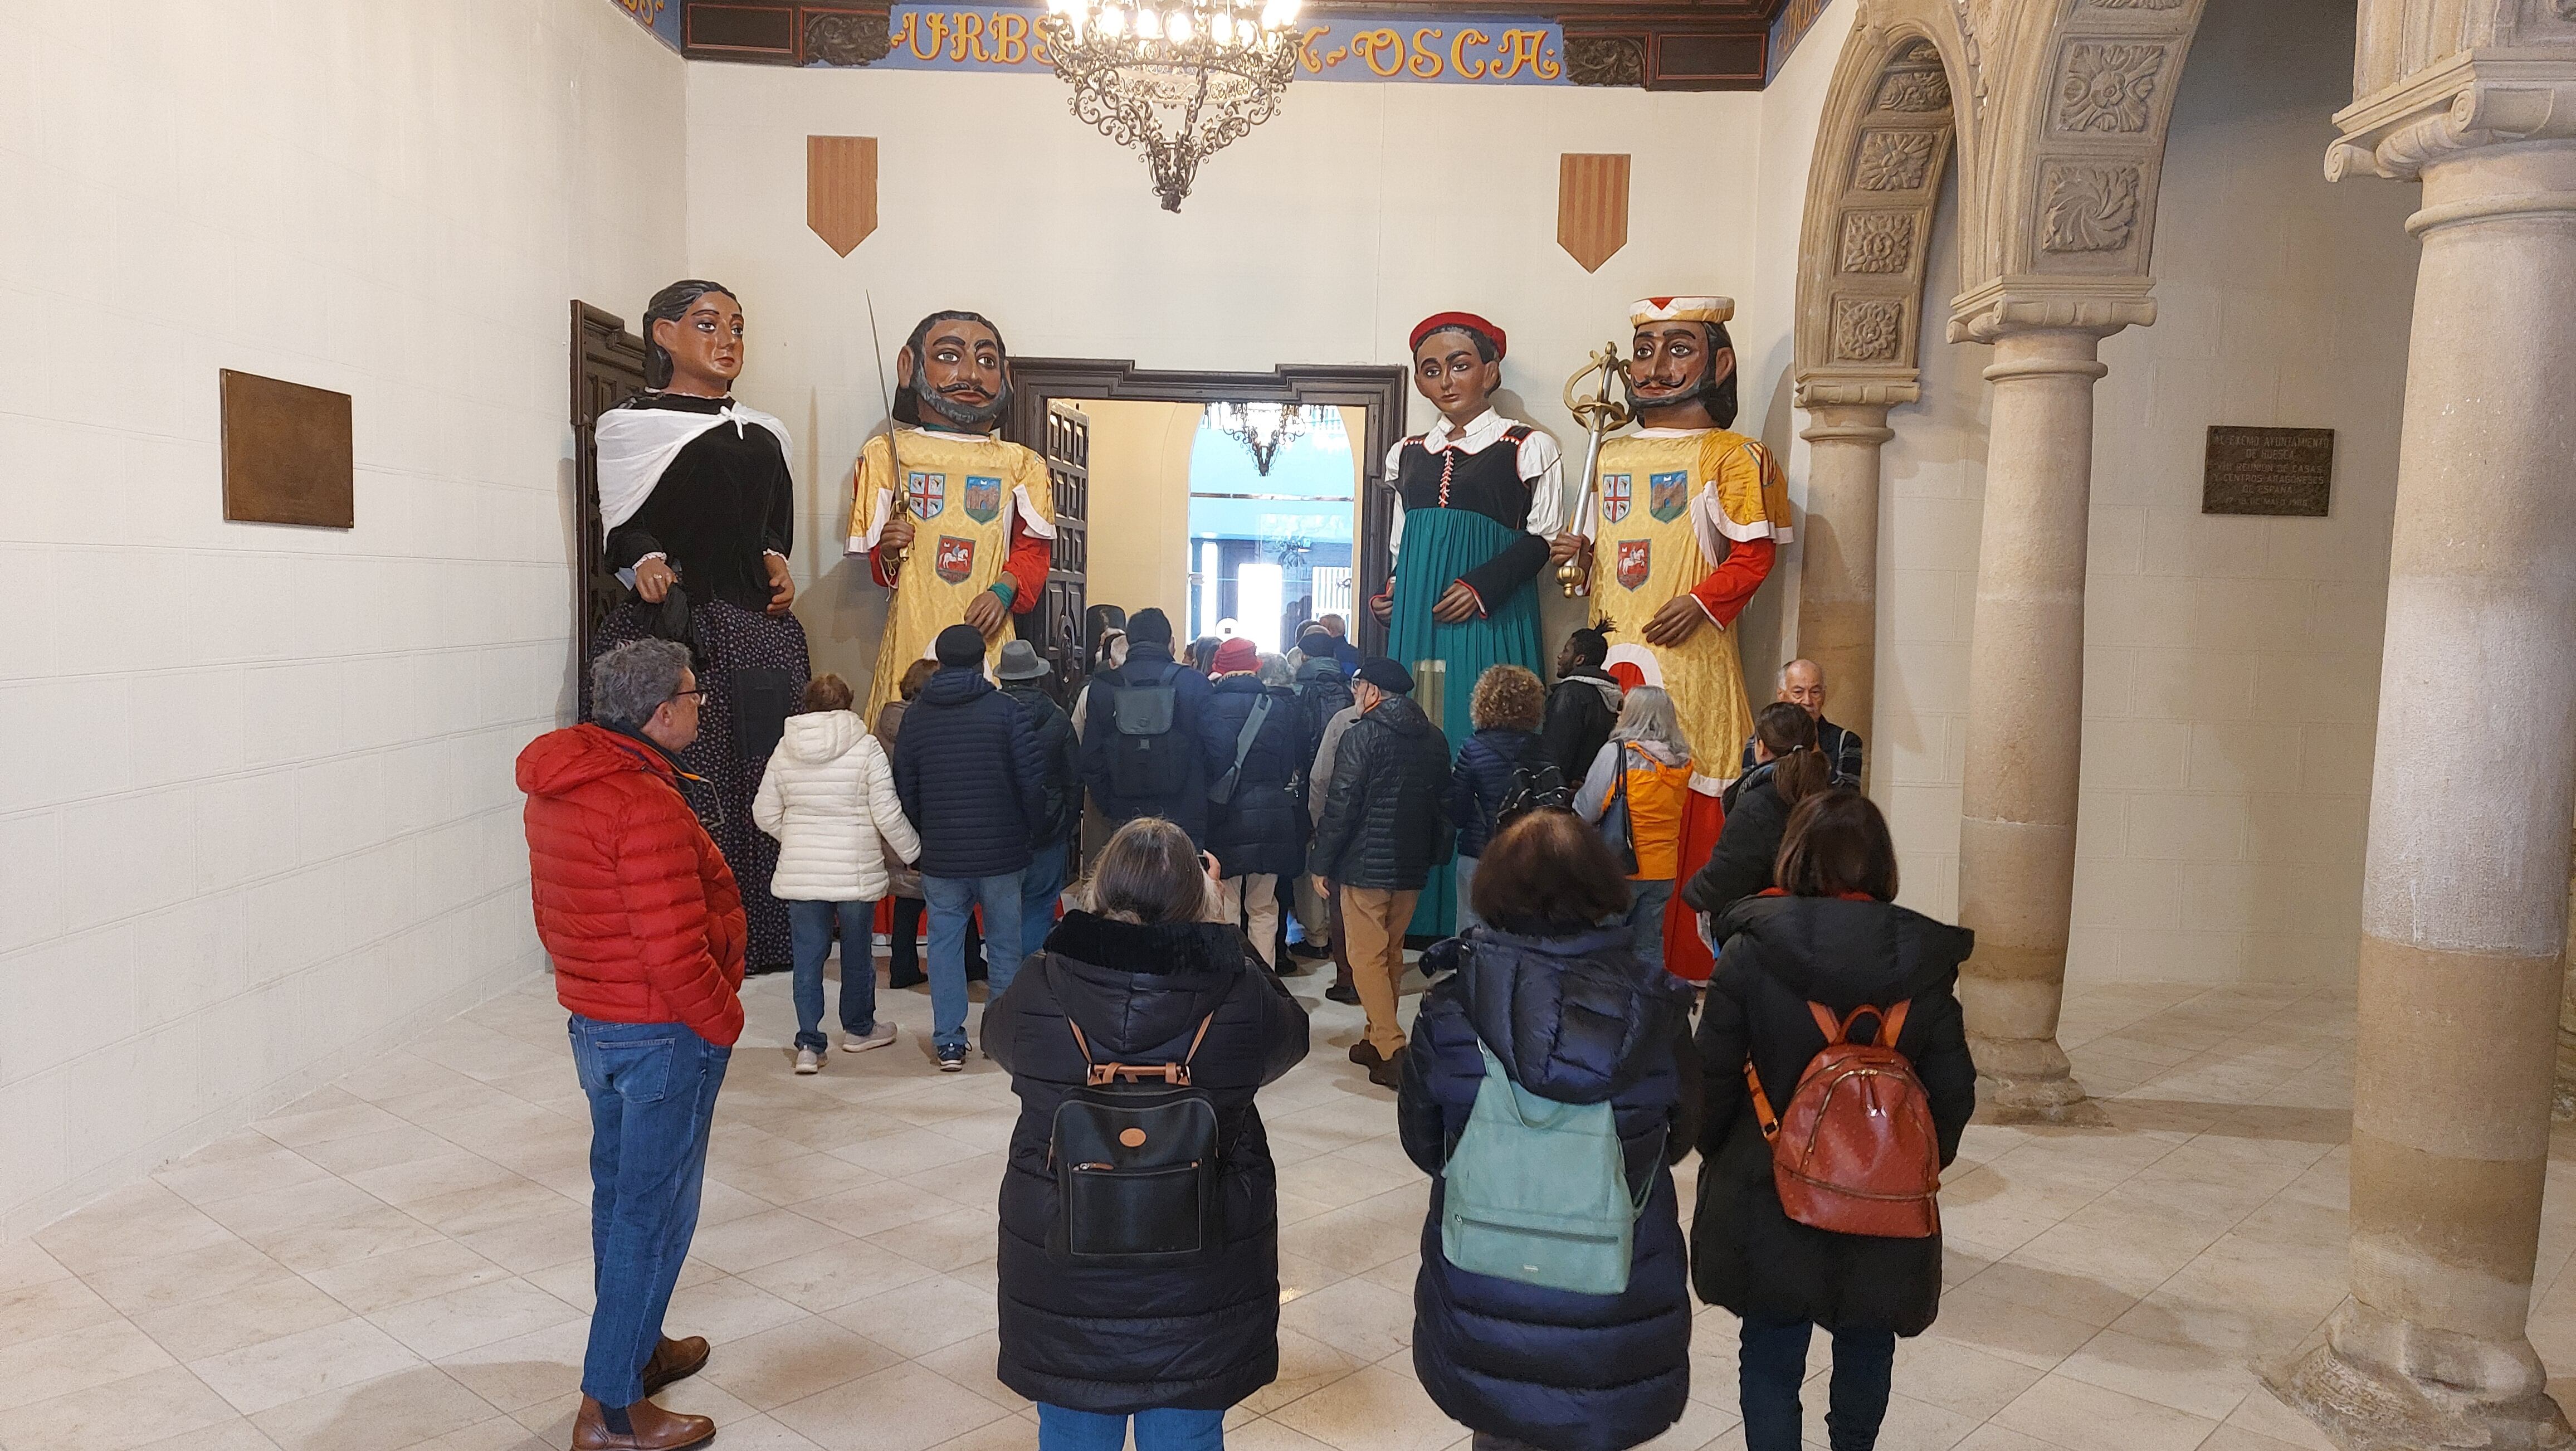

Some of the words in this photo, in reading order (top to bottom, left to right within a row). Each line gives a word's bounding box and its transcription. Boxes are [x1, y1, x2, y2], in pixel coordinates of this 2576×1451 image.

[2263, 436, 2330, 449] AYUNTAMIENTO
[2245, 448, 2258, 459] DE
[2261, 449, 2295, 460] HUESCA
[2276, 463, 2289, 473] DE
[2292, 464, 2324, 474] CASAS
[2223, 473, 2263, 483] CENTROS
[2265, 474, 2324, 485] ARAGONESES
[2242, 484, 2255, 494] DE
